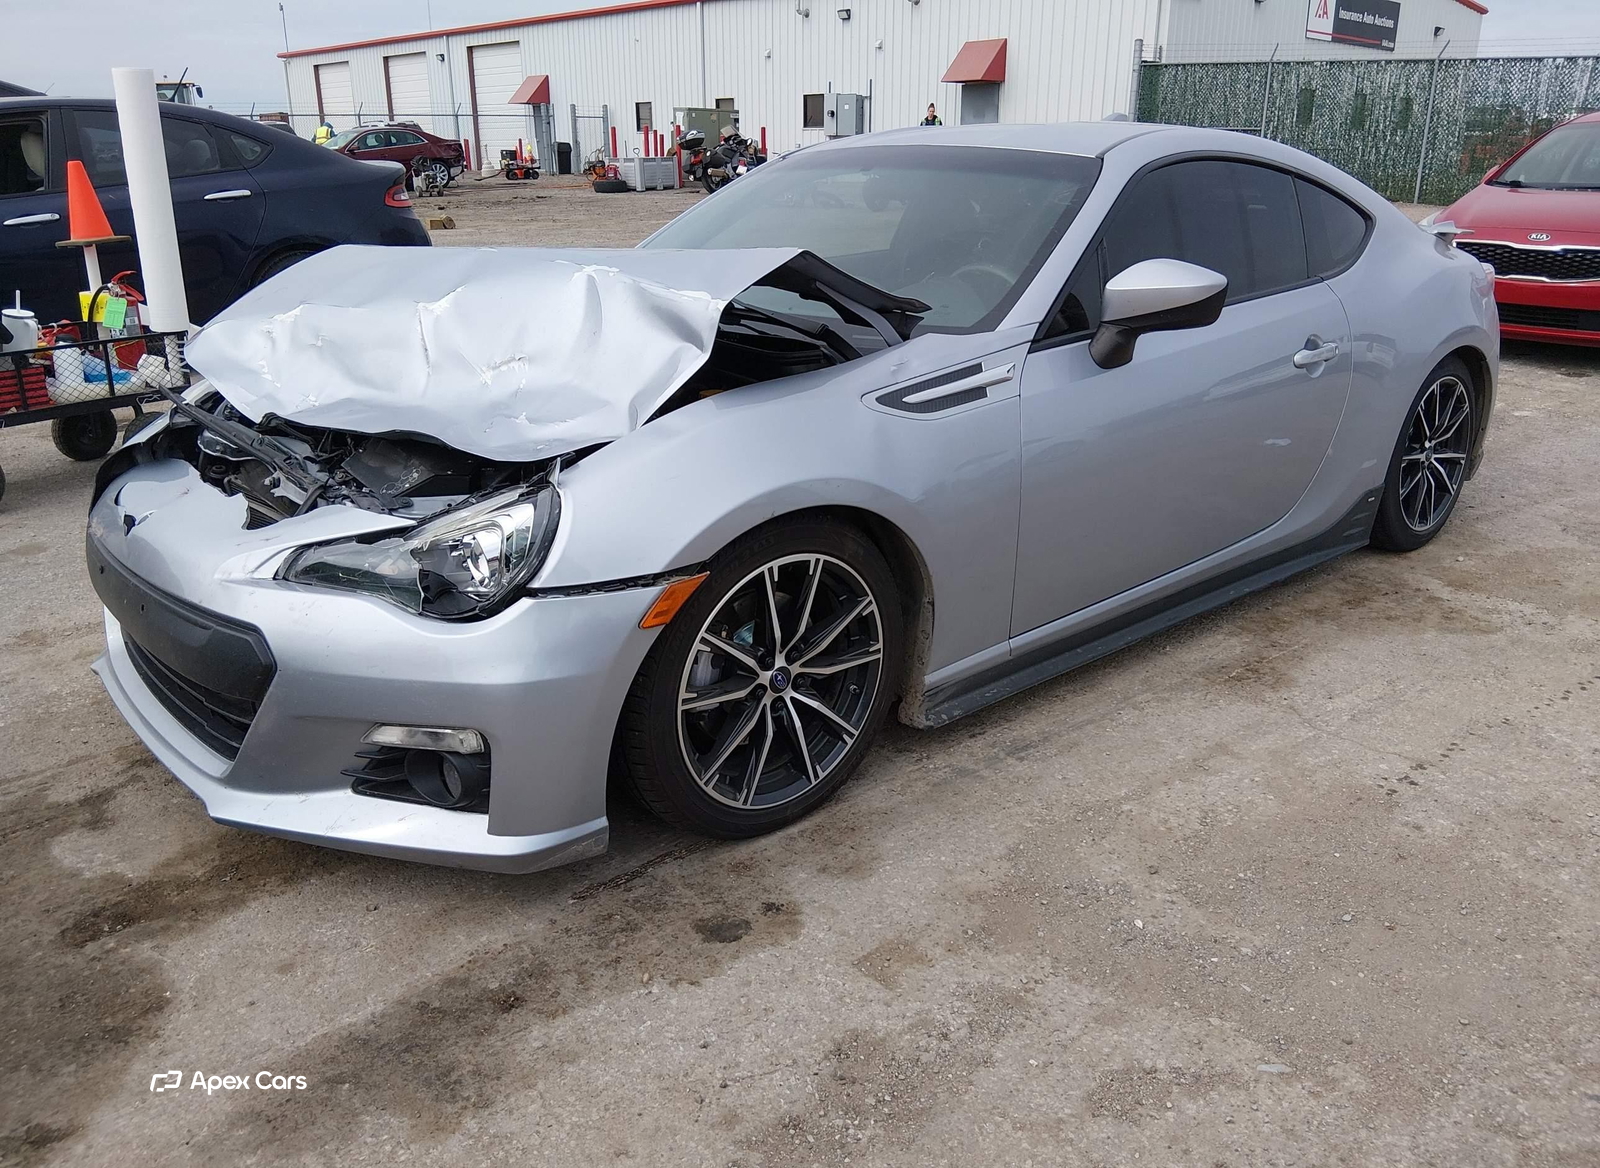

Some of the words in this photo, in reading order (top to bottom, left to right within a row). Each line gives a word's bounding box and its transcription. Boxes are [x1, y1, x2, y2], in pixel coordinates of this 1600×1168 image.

[1338, 6, 1363, 22] Insurance
[1363, 11, 1374, 24] Auto
[1374, 13, 1394, 28] Auctions
[1530, 232, 1548, 240] KIA
